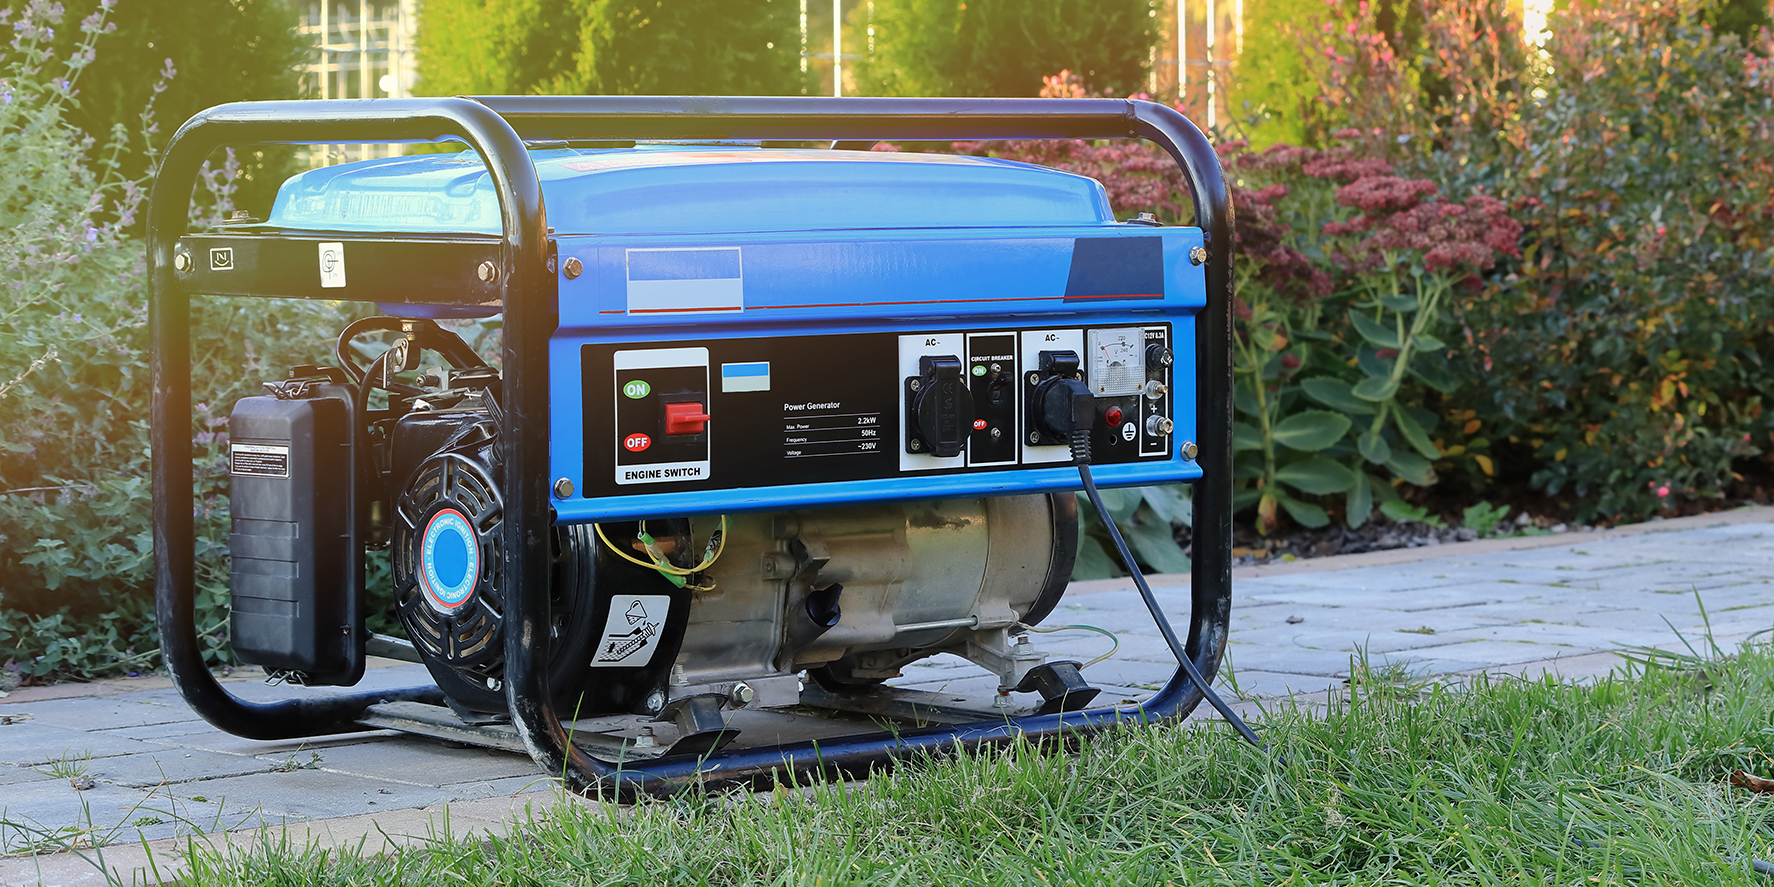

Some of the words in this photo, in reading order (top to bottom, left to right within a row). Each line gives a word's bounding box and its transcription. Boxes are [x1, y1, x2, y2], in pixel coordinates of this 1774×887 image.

[973, 367, 984, 375] ON
[626, 384, 646, 396] ON
[784, 403, 806, 411] Power
[806, 401, 840, 410] Generator
[857, 417, 876, 425] 2.2kW
[861, 429, 876, 437] 50Hz
[626, 437, 648, 448] OFF
[625, 469, 662, 480] ENGINE
[664, 467, 701, 478] SWITCH
[426, 517, 454, 555] ELECTRONIC
[454, 517, 474, 555] IGNITION
[426, 562, 446, 597] IGNITION
[446, 562, 475, 600] ELECTRONIC
